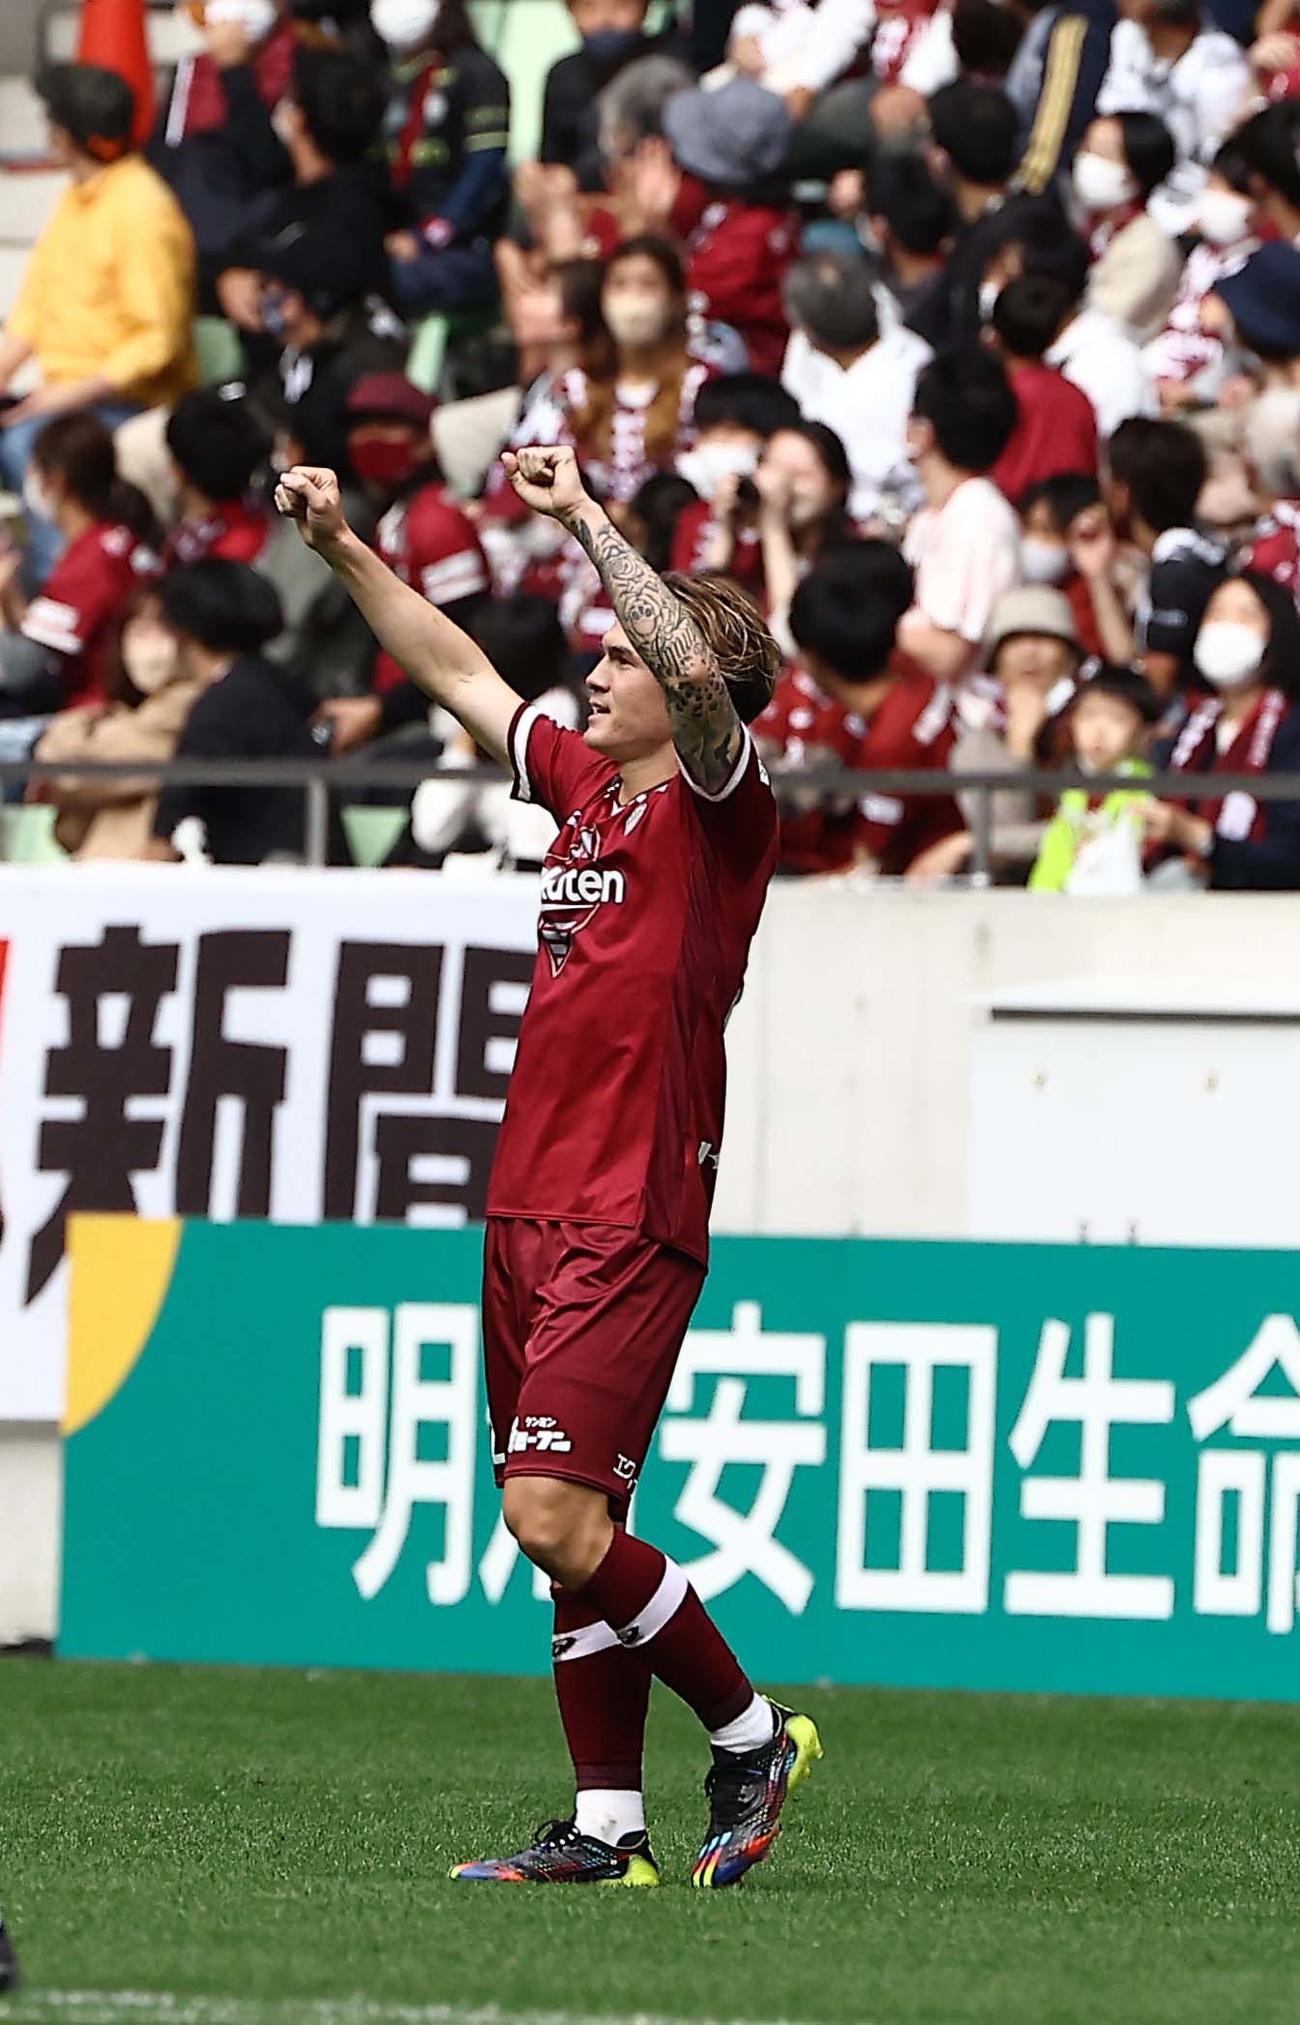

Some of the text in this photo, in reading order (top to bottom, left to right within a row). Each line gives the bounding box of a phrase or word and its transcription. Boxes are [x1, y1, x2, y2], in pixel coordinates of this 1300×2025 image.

[24, 925, 539, 1309] 新聞
[314, 1300, 1300, 1636] 明安田生命
